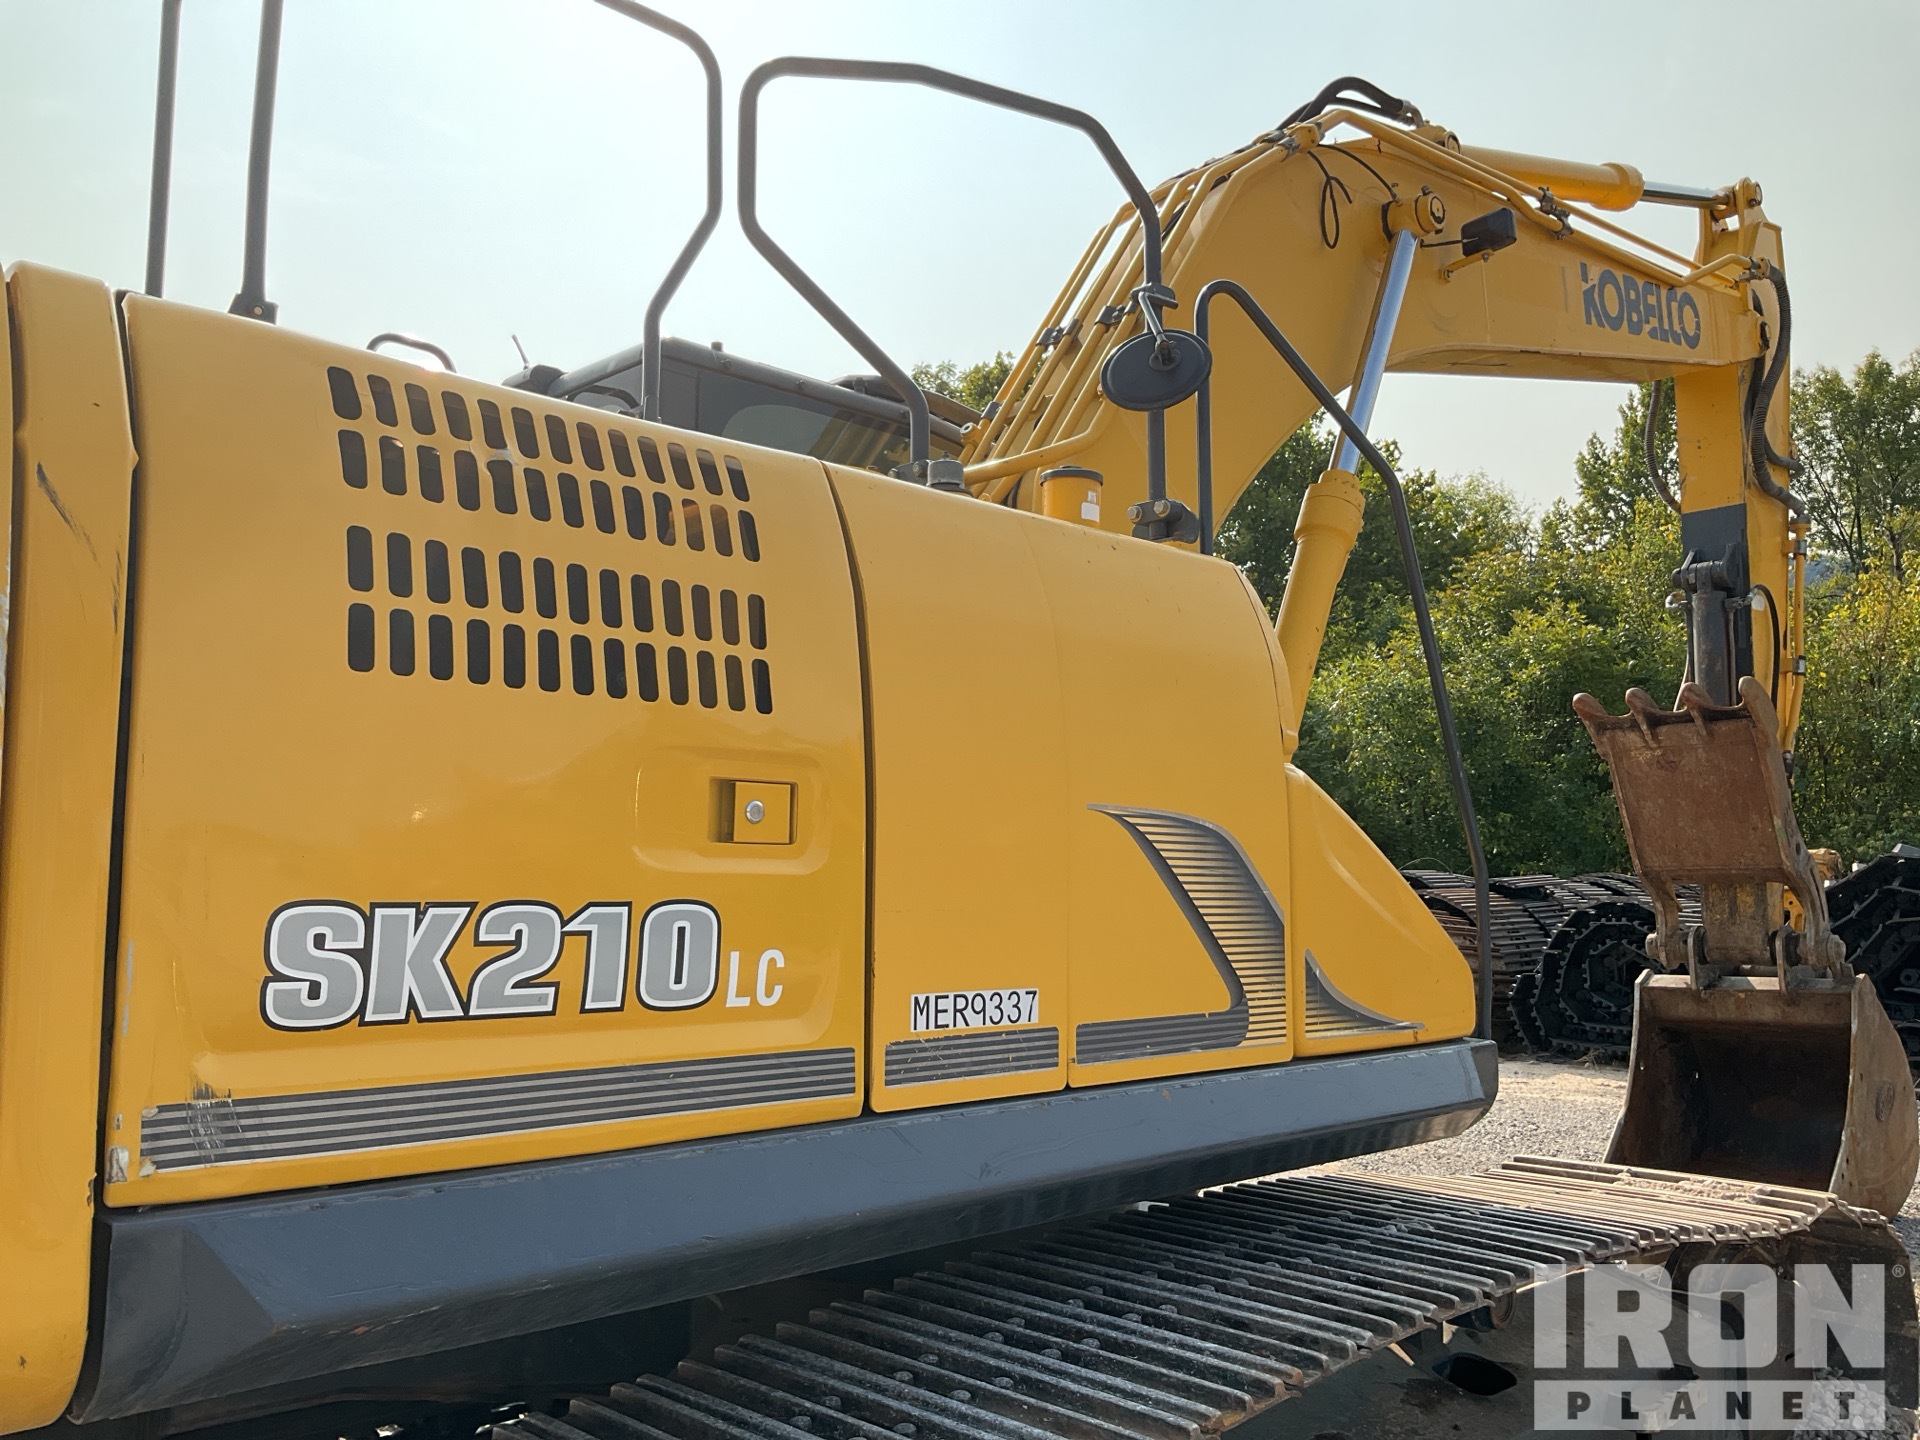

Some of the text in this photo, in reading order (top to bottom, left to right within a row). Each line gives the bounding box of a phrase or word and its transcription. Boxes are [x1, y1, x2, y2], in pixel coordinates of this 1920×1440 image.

[1580, 261, 1701, 350] KOBELCO
[261, 900, 786, 1031] SK210 LC
[912, 989, 1038, 1031] MER9337
